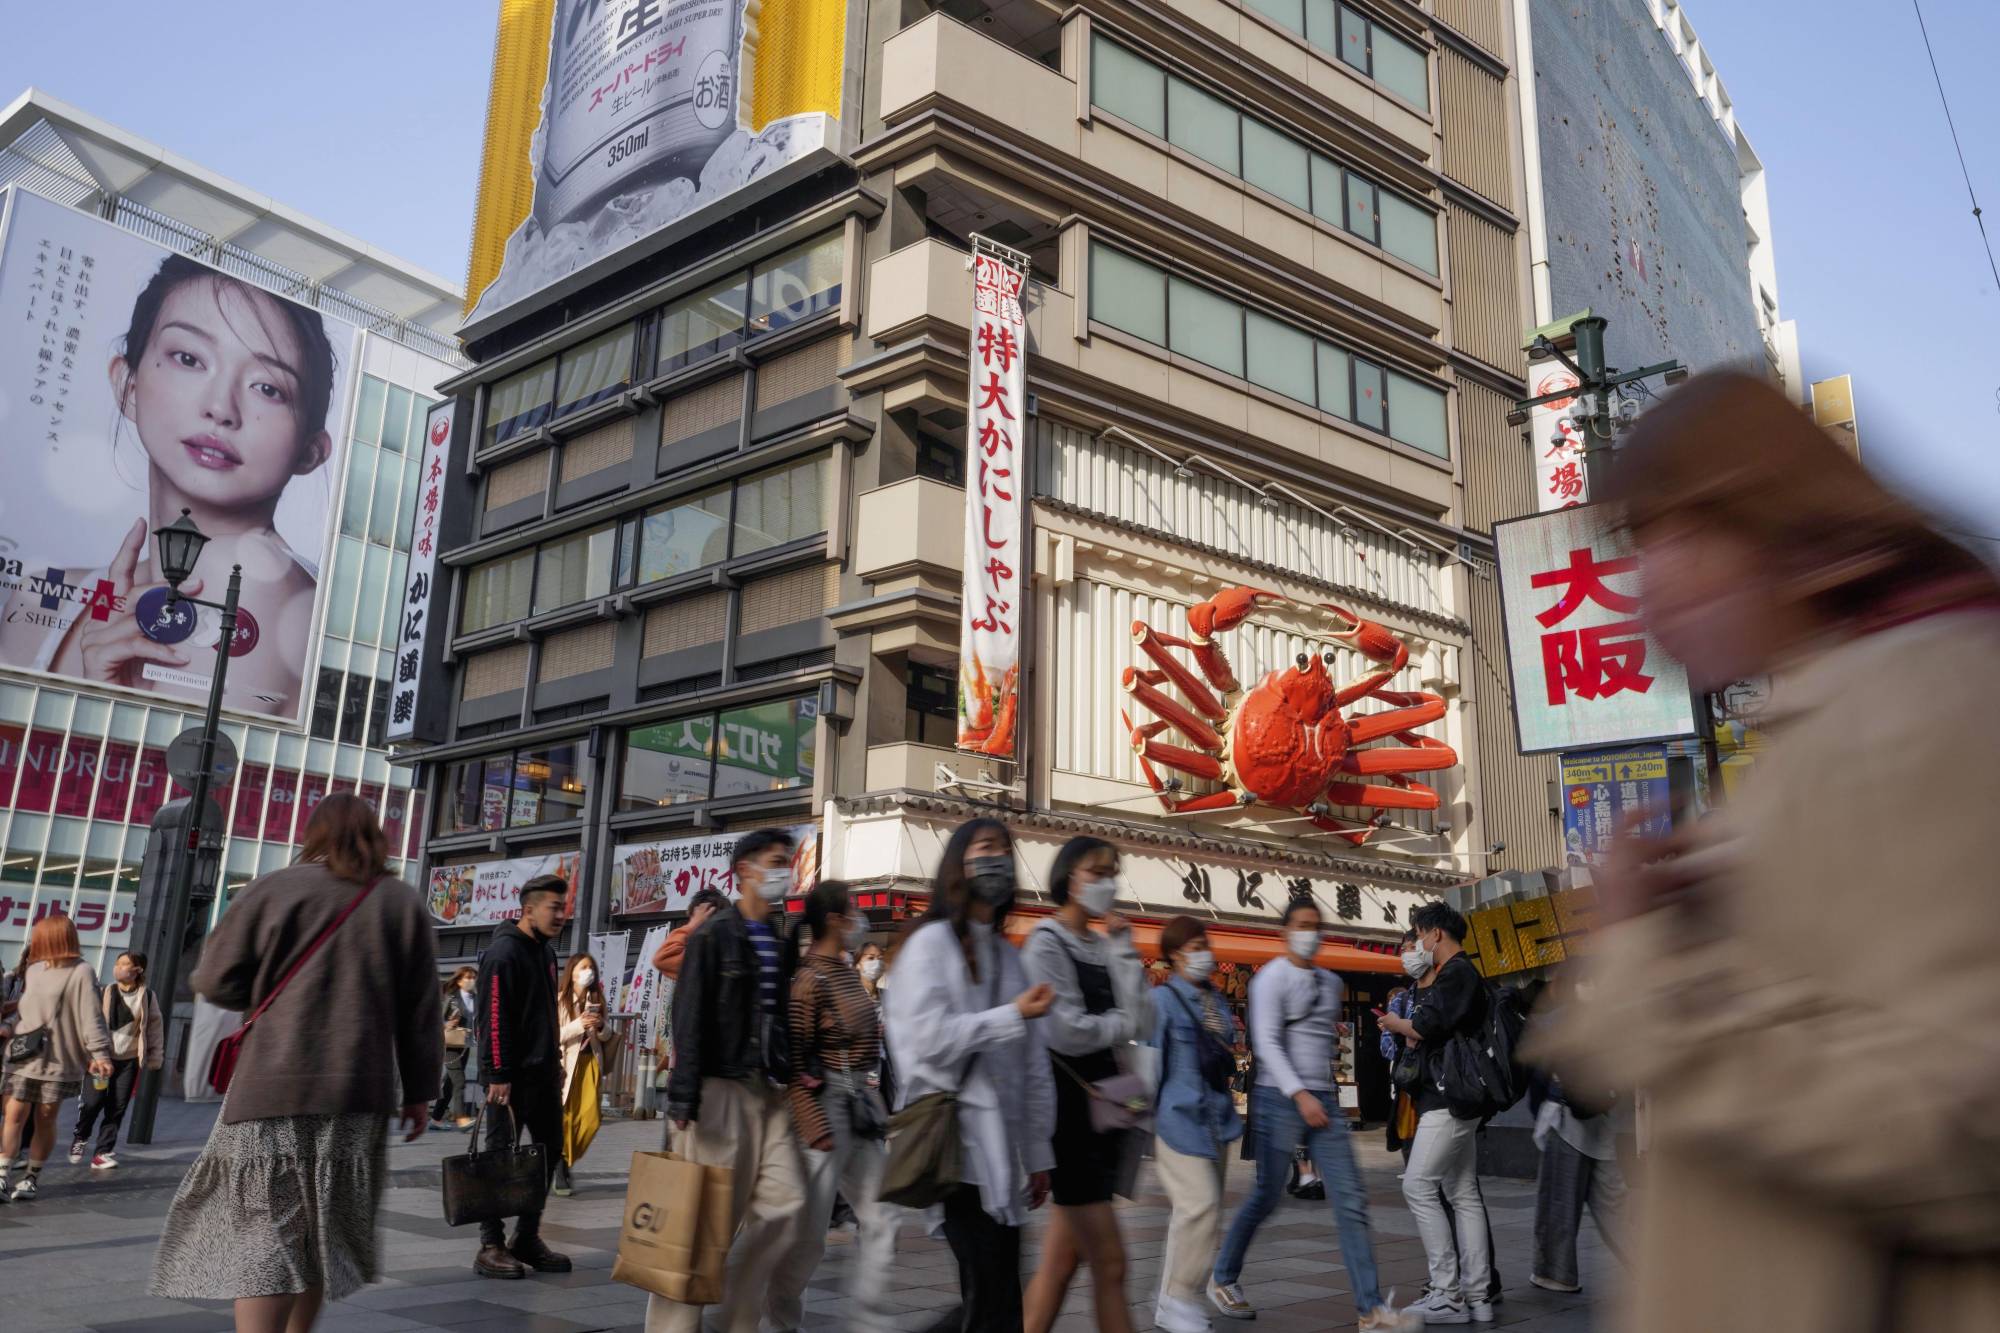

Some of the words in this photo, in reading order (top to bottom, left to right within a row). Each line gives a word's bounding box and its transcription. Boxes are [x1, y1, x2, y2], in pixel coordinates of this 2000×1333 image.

[587, 35, 687, 113] スーパードライ
[695, 74, 731, 110] お酒
[607, 127, 650, 169] 350ml
[971, 321, 1019, 635] 特大かにしゃぶ
[1531, 548, 1656, 706] 大阪
[1566, 768, 1591, 778] 340m
[1636, 762, 1663, 772] 240m
[674, 865, 743, 897] かにす
